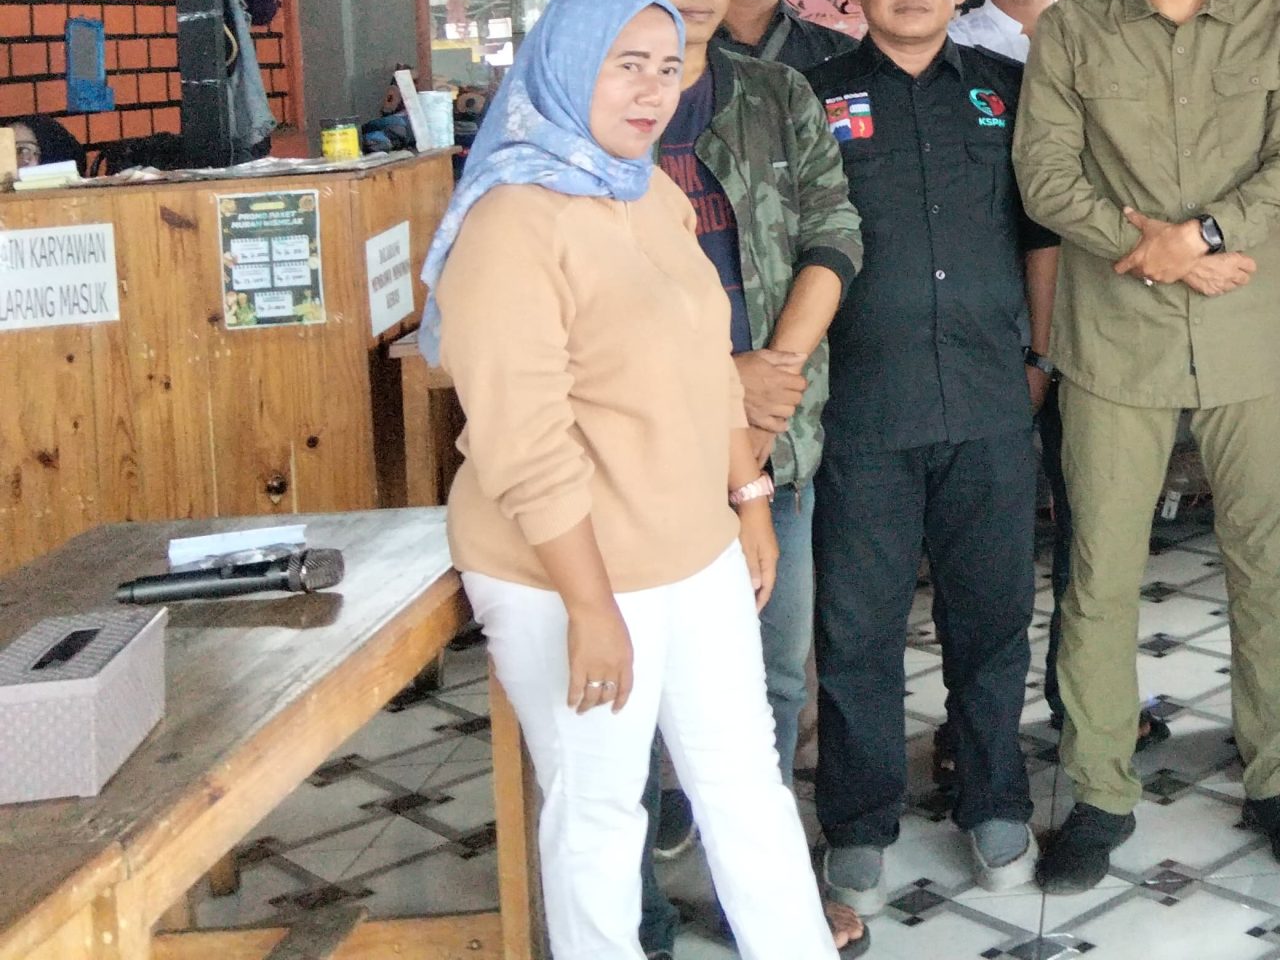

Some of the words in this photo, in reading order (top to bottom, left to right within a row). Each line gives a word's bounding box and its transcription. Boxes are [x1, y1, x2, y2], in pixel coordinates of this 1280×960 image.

[237, 212, 268, 221] PROMO
[29, 232, 107, 268] KARYAWAN
[59, 281, 109, 316] MASUK
